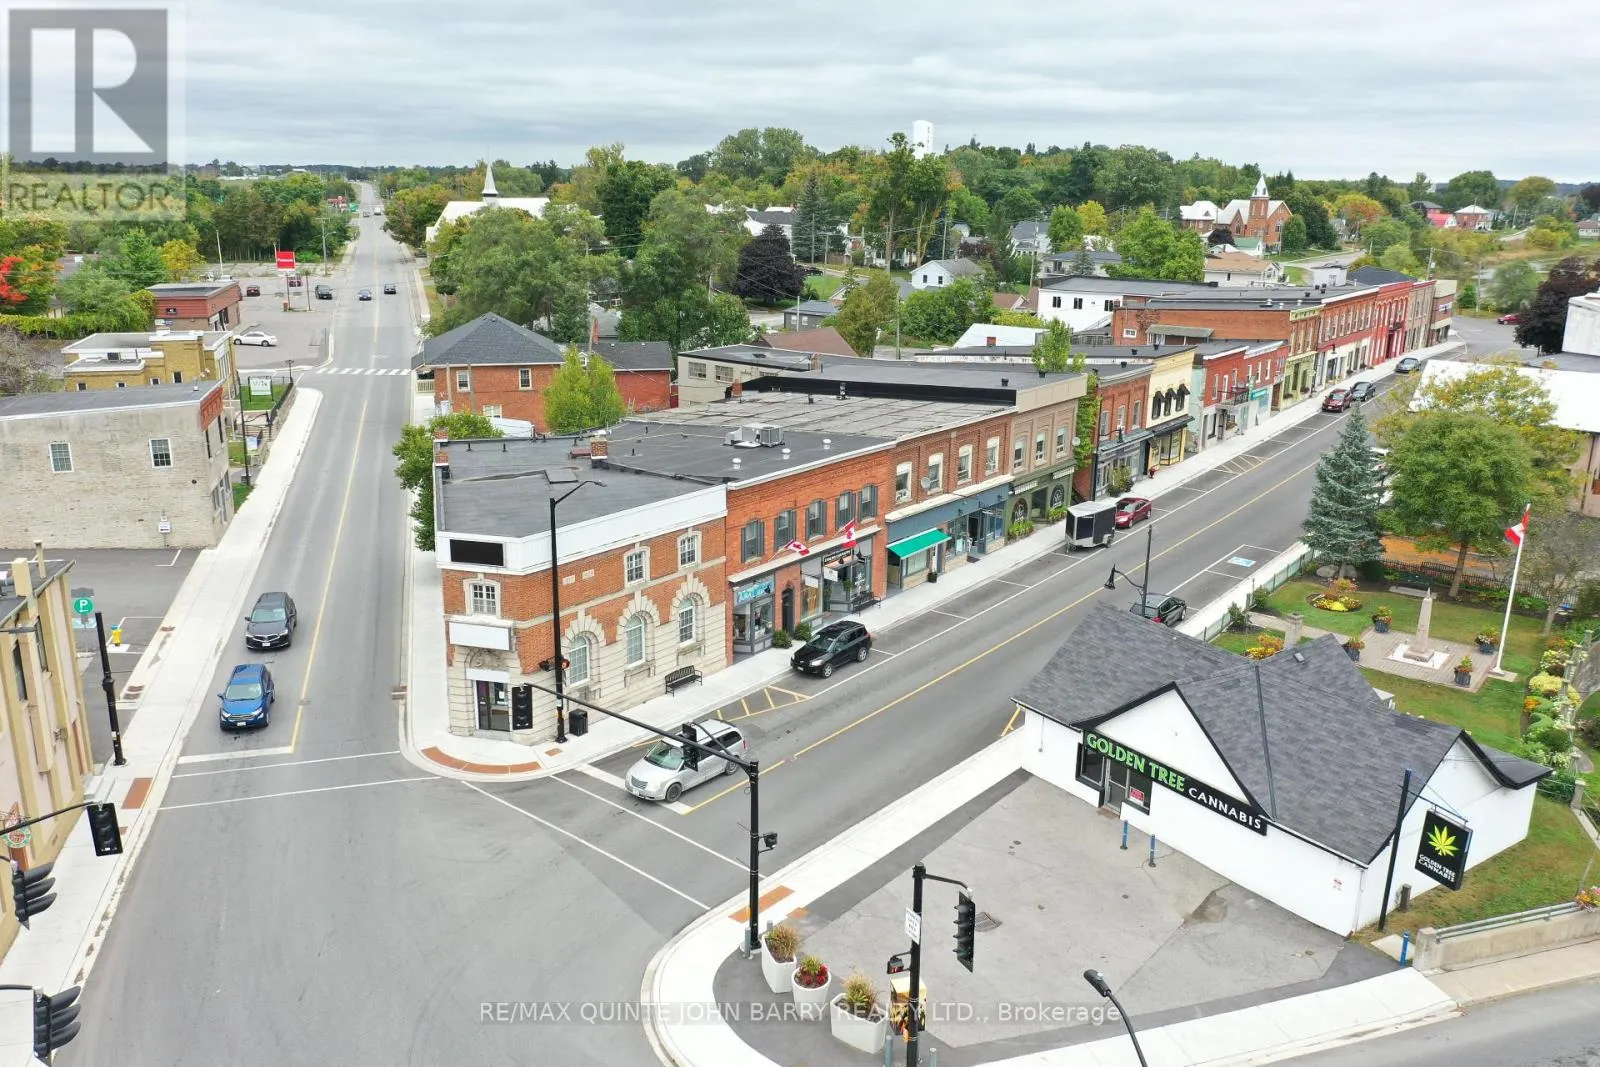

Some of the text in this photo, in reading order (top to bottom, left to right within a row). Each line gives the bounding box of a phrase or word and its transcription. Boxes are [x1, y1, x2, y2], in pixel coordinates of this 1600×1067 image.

[80, 599, 88, 610] P
[1087, 733, 1145, 773] GOLDEN
[1149, 762, 1185, 792] TREE
[1188, 787, 1261, 829] CANNABIS
[1419, 854, 1442, 870] GOLDEN
